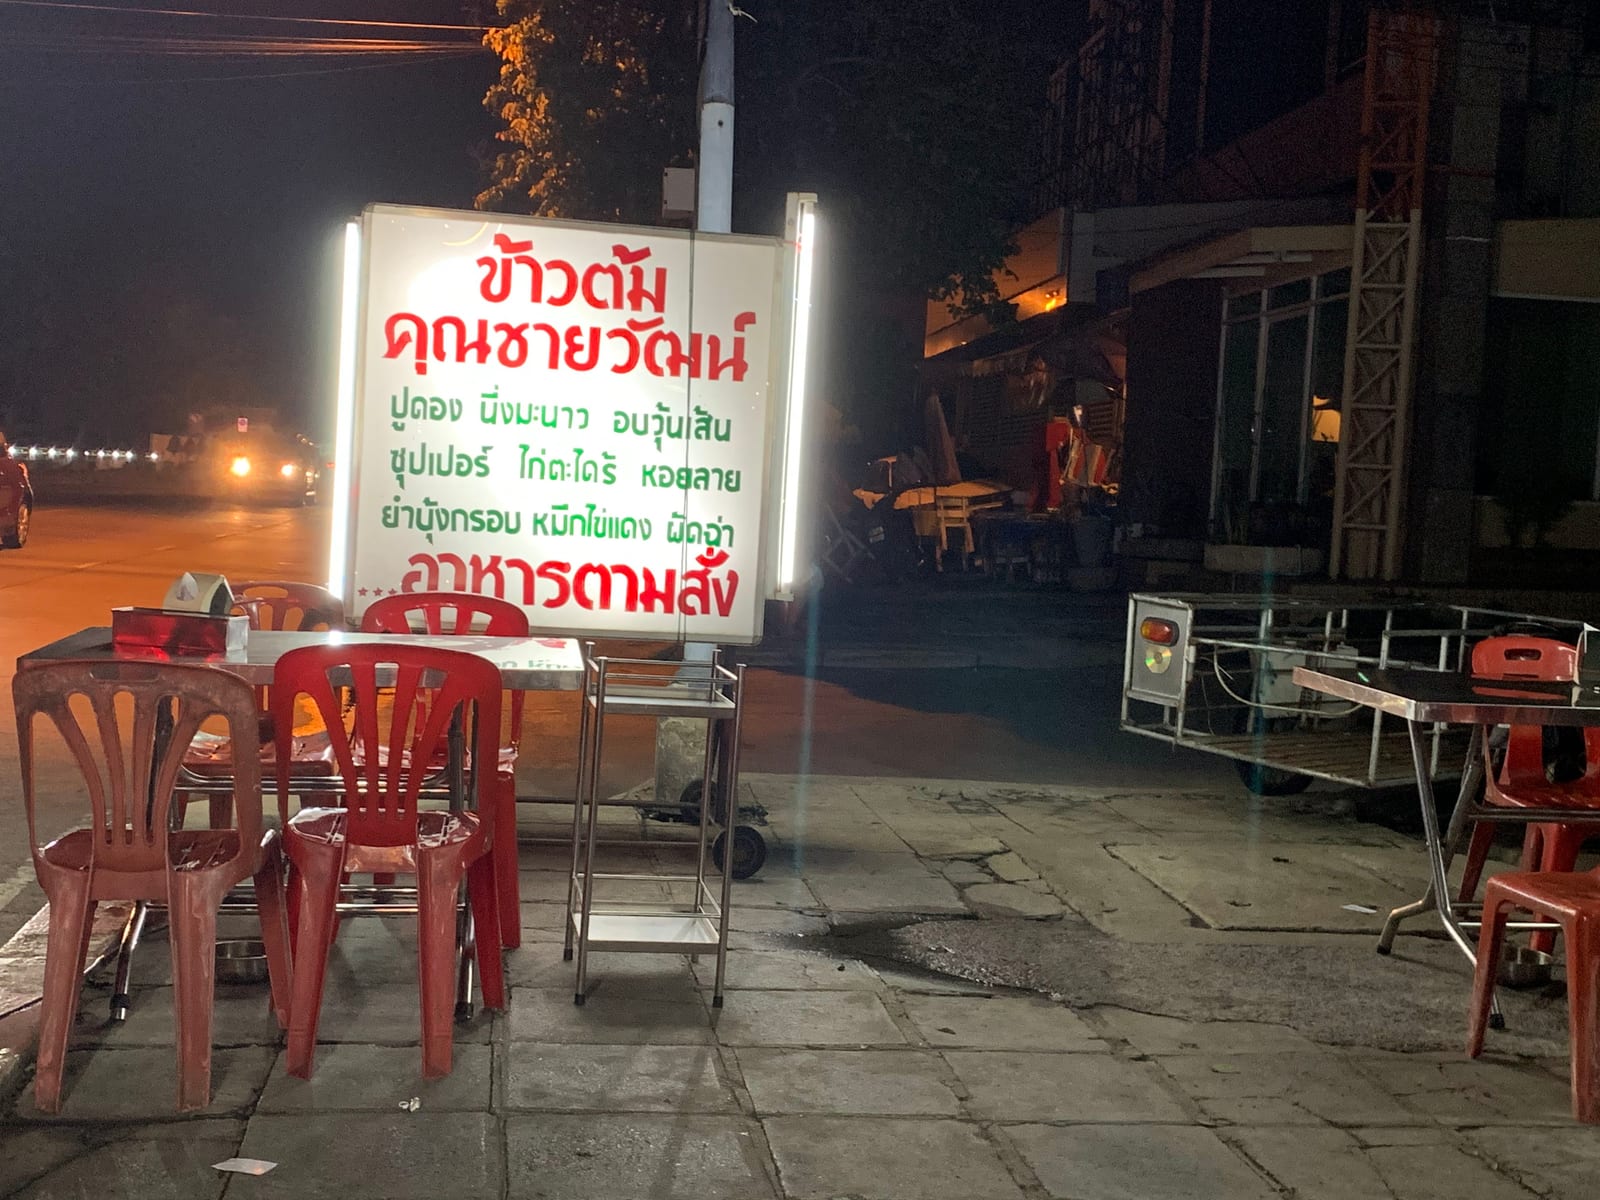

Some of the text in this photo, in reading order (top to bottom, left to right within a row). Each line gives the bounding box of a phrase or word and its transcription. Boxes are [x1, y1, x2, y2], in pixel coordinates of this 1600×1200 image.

[476, 233, 667, 313] ข้าวต้ม
[391, 386, 463, 431] ปูดอง
[613, 401, 731, 447] อบวุ้นเส้น
[642, 464, 741, 492] หอยลาย
[382, 495, 521, 544] ยำบุ้งกรอบ
[666, 511, 734, 547] ผัดฉ่า
[401, 546, 739, 617] อาหารตามสั่ง
